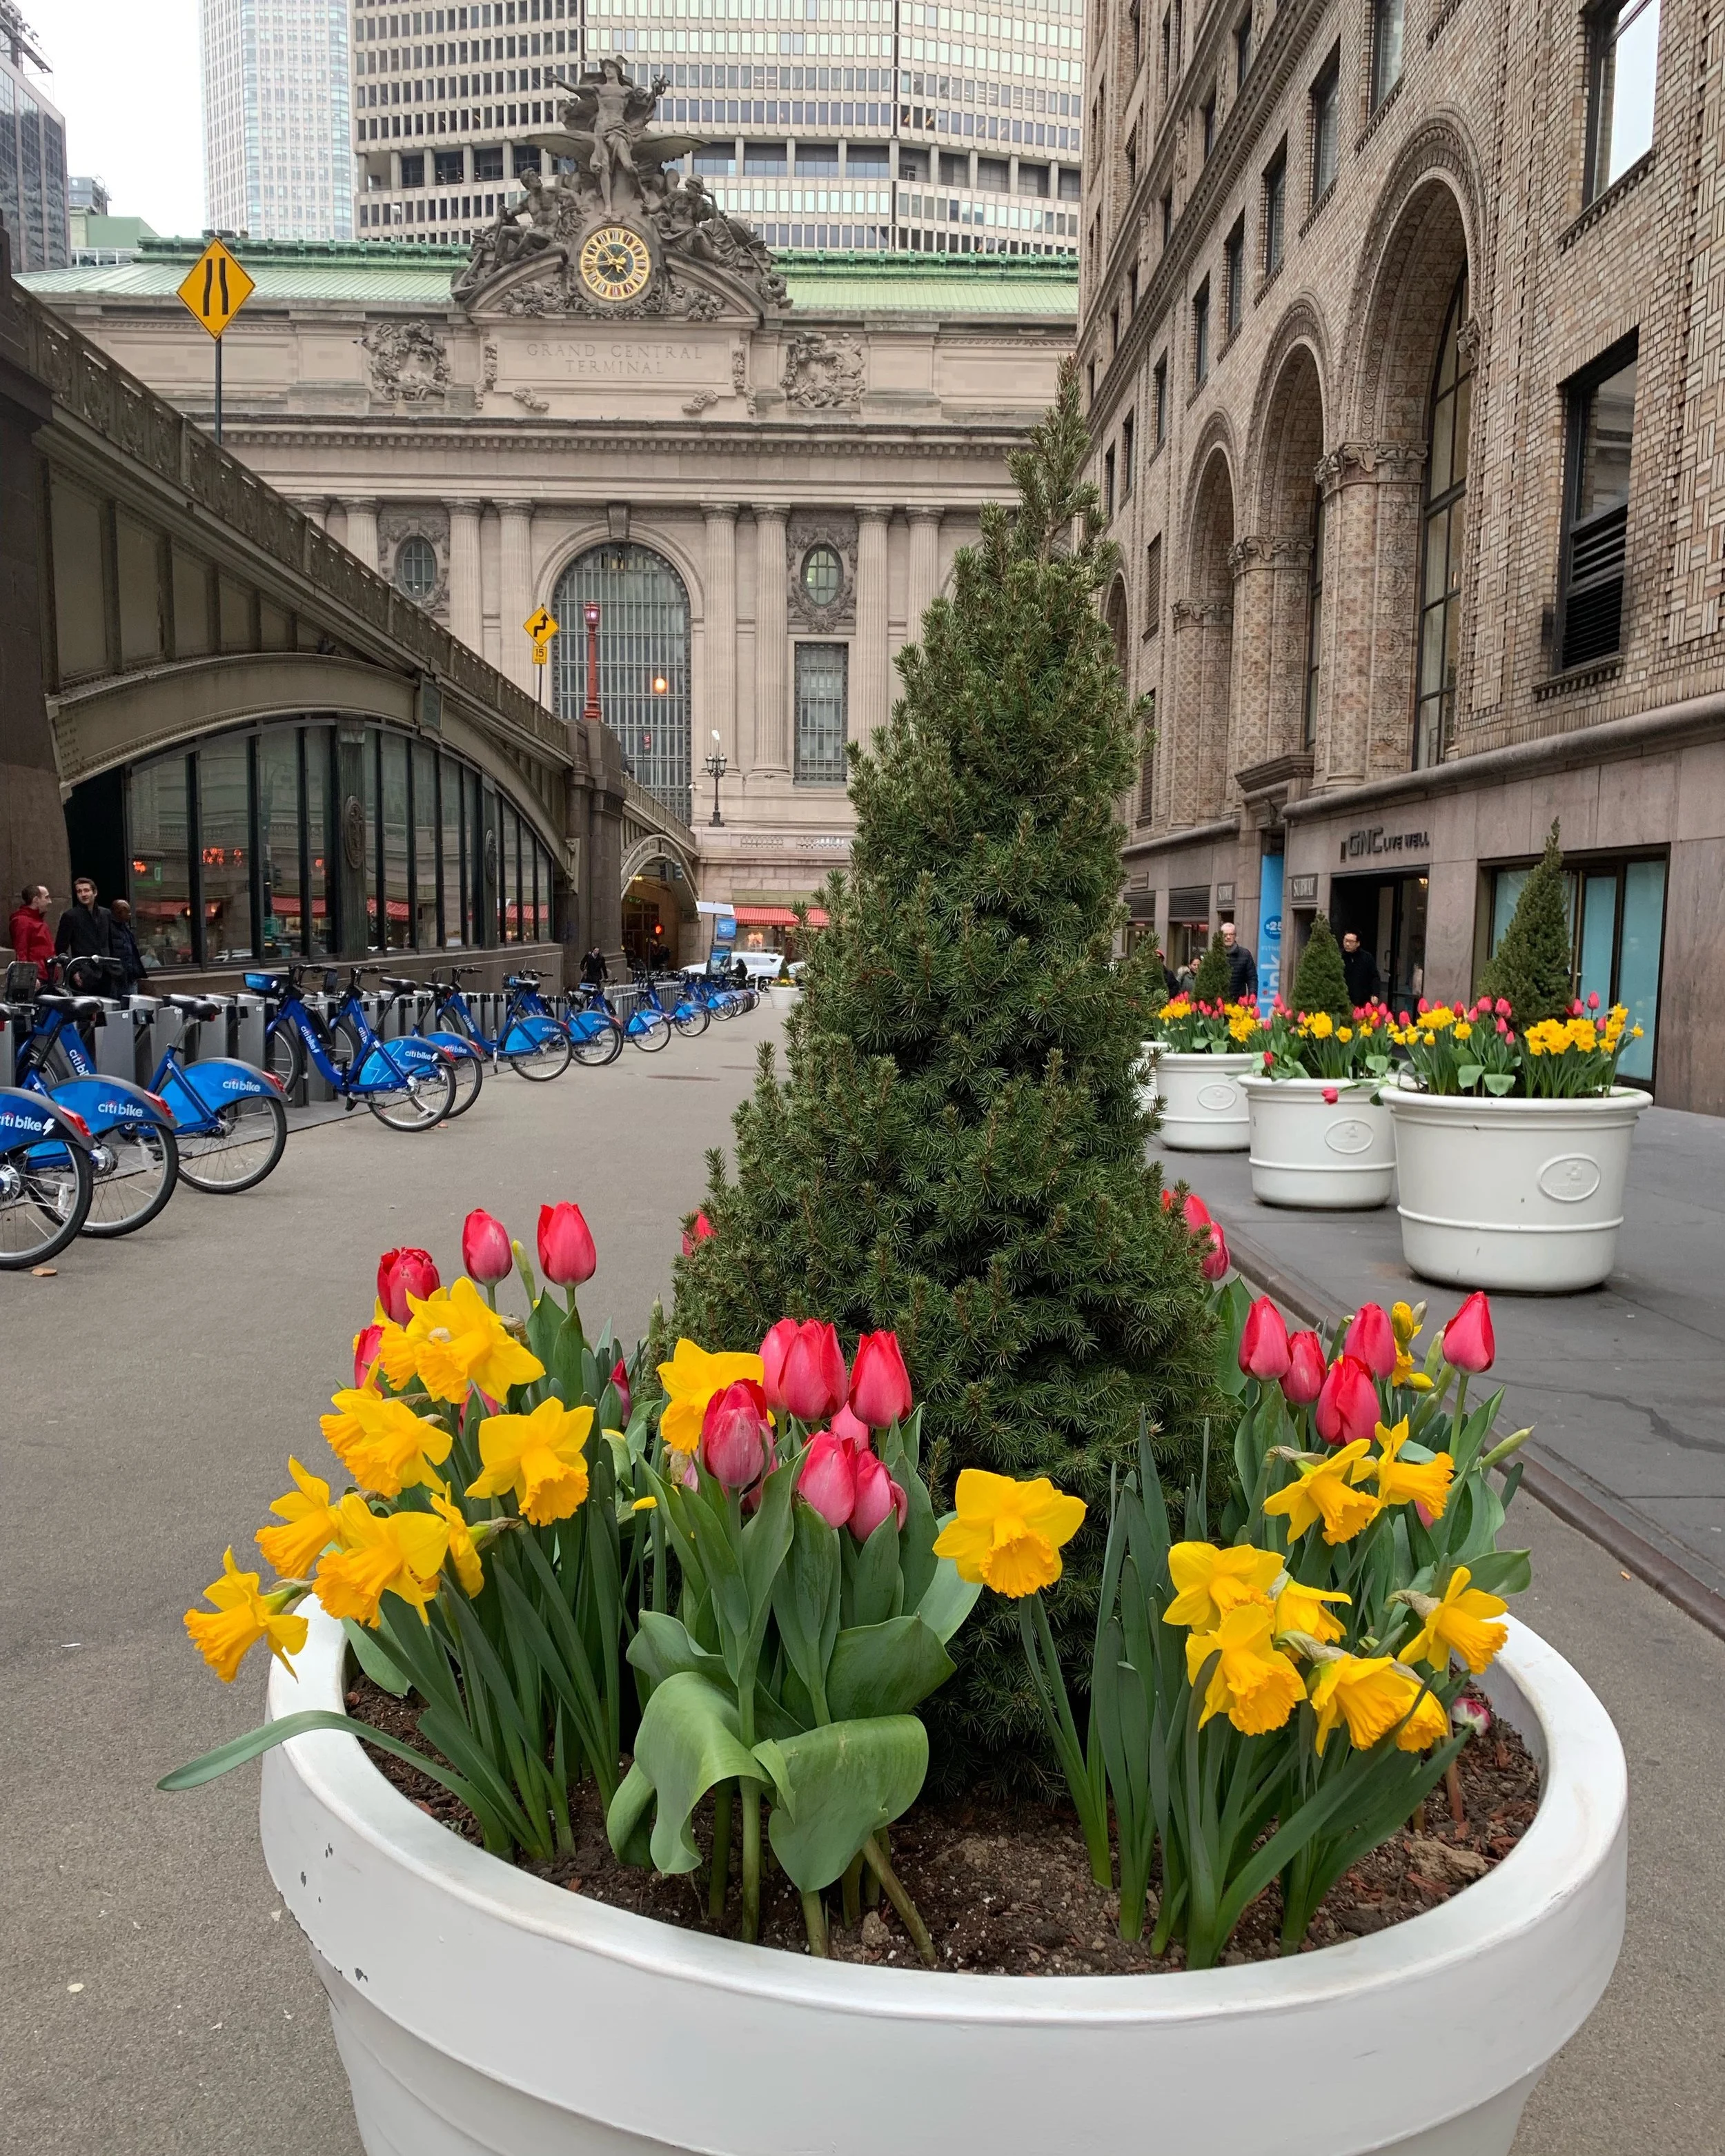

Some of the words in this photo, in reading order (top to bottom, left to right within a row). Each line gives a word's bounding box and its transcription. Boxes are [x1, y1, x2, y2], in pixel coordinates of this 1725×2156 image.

[527, 344, 595, 357] GRAND
[611, 344, 702, 359] CENTRAL
[565, 359, 663, 374] TERMINAL
[535, 649, 544, 657] 15
[1348, 827, 1383, 856] GNC
[1383, 835, 1403, 851] LIVE
[1405, 831, 1430, 848] WELL
[416, 1051, 431, 1060] bike
[222, 1080, 239, 1090] citi
[239, 1080, 261, 1092] bike
[97, 1102, 117, 1114] citi
[117, 1103, 144, 1118] bike
[14, 1115, 42, 1131] bike
